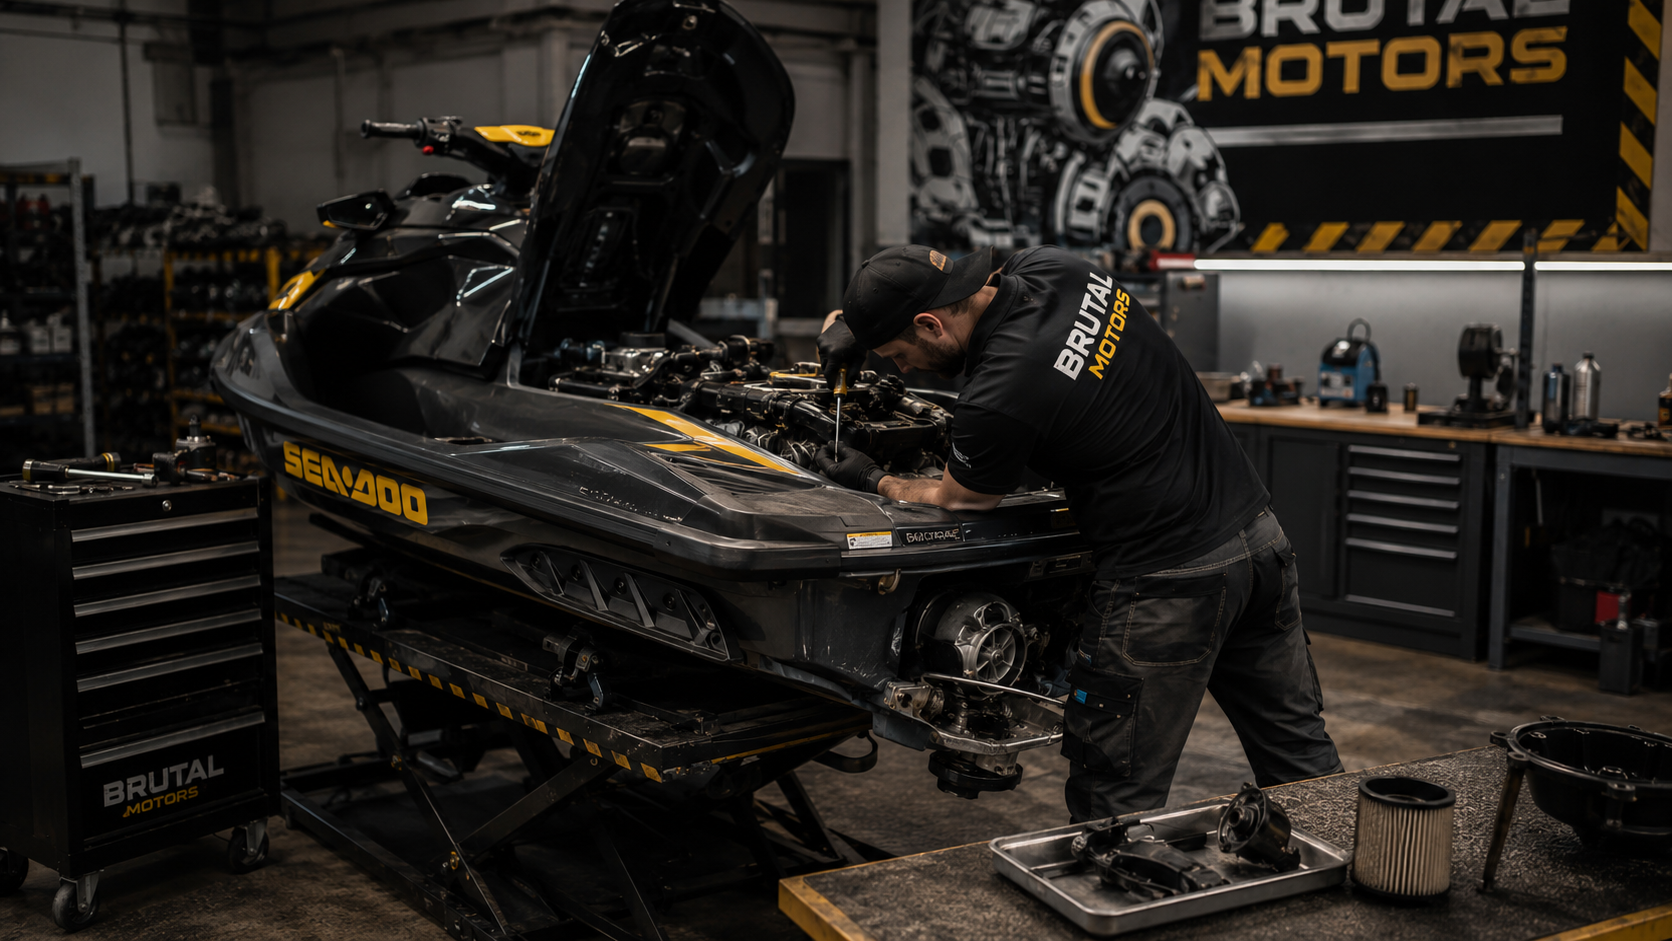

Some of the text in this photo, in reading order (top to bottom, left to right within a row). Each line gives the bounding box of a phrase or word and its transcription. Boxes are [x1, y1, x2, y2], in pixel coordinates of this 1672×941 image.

[1200, 0, 1570, 41] BRU
[1197, 26, 1568, 101] MOTORS
[1053, 271, 1114, 381] BRUTAL
[1088, 288, 1130, 380] MOTORS
[103, 754, 224, 807] BRUTAL
[123, 785, 199, 818] MOTORS
